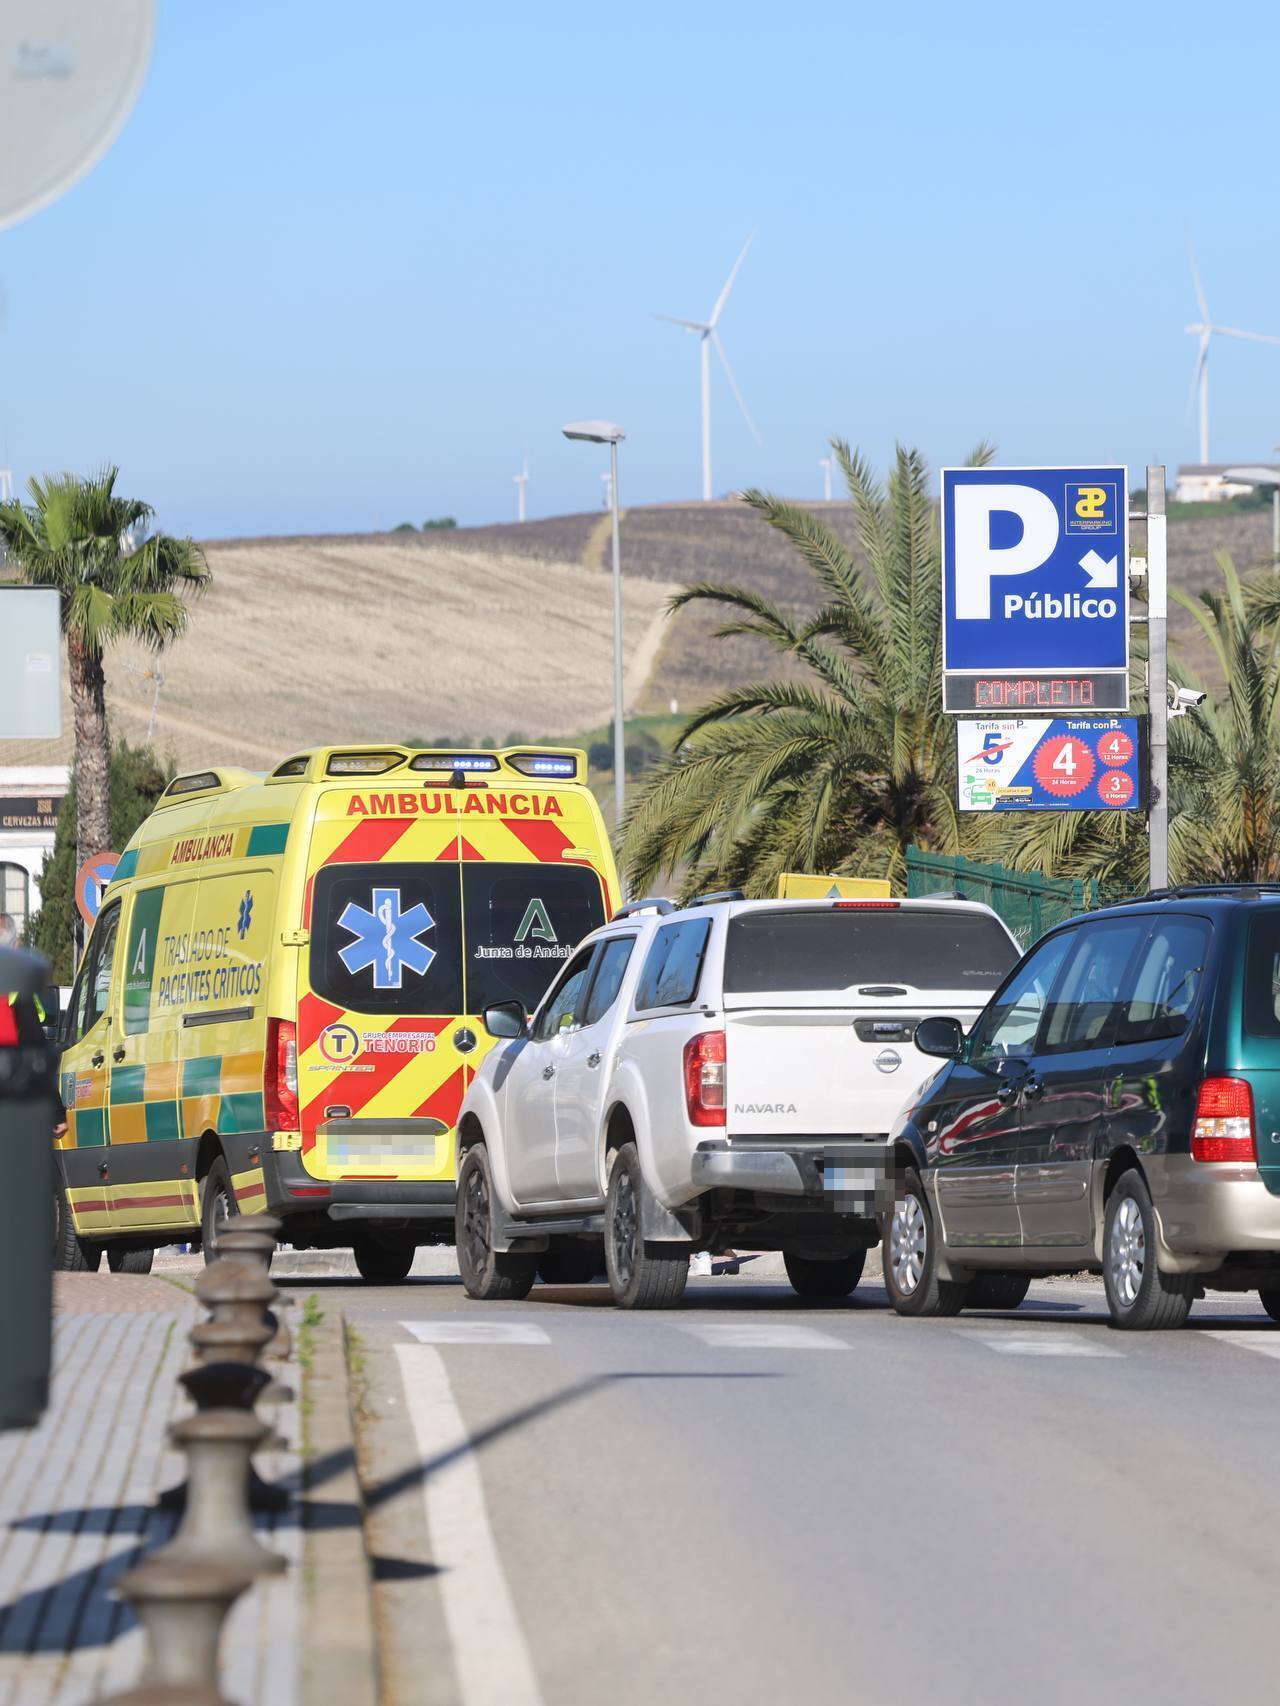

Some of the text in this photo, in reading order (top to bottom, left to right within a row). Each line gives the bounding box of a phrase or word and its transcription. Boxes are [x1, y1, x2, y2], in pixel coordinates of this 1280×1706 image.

[955, 484, 1059, 620] P
[1004, 592, 1117, 619] Público
[976, 680, 1094, 705] COMPLETO
[975, 722, 999, 731] Tarifa
[1001, 722, 1015, 730] sin
[1066, 721, 1091, 730] Tarifa
[1093, 721, 1110, 729] con
[1109, 738, 1120, 753] 4
[1053, 742, 1077, 775] 4
[1111, 777, 1121, 791] 3
[346, 793, 563, 817] AMBULANCIA
[2, 815, 42, 827] CERVEZAS
[170, 833, 234, 865] AMBULANCIA
[163, 927, 231, 968] TRASLADO DE
[474, 945, 513, 959] Junta
[514, 945, 532, 958] de
[158, 958, 262, 1008] PACIENTES CRÍTICOS
[363, 1039, 436, 1053] TENORIO
[307, 1064, 376, 1073] SPRINTER
[734, 1103, 797, 1114] NAVARA
